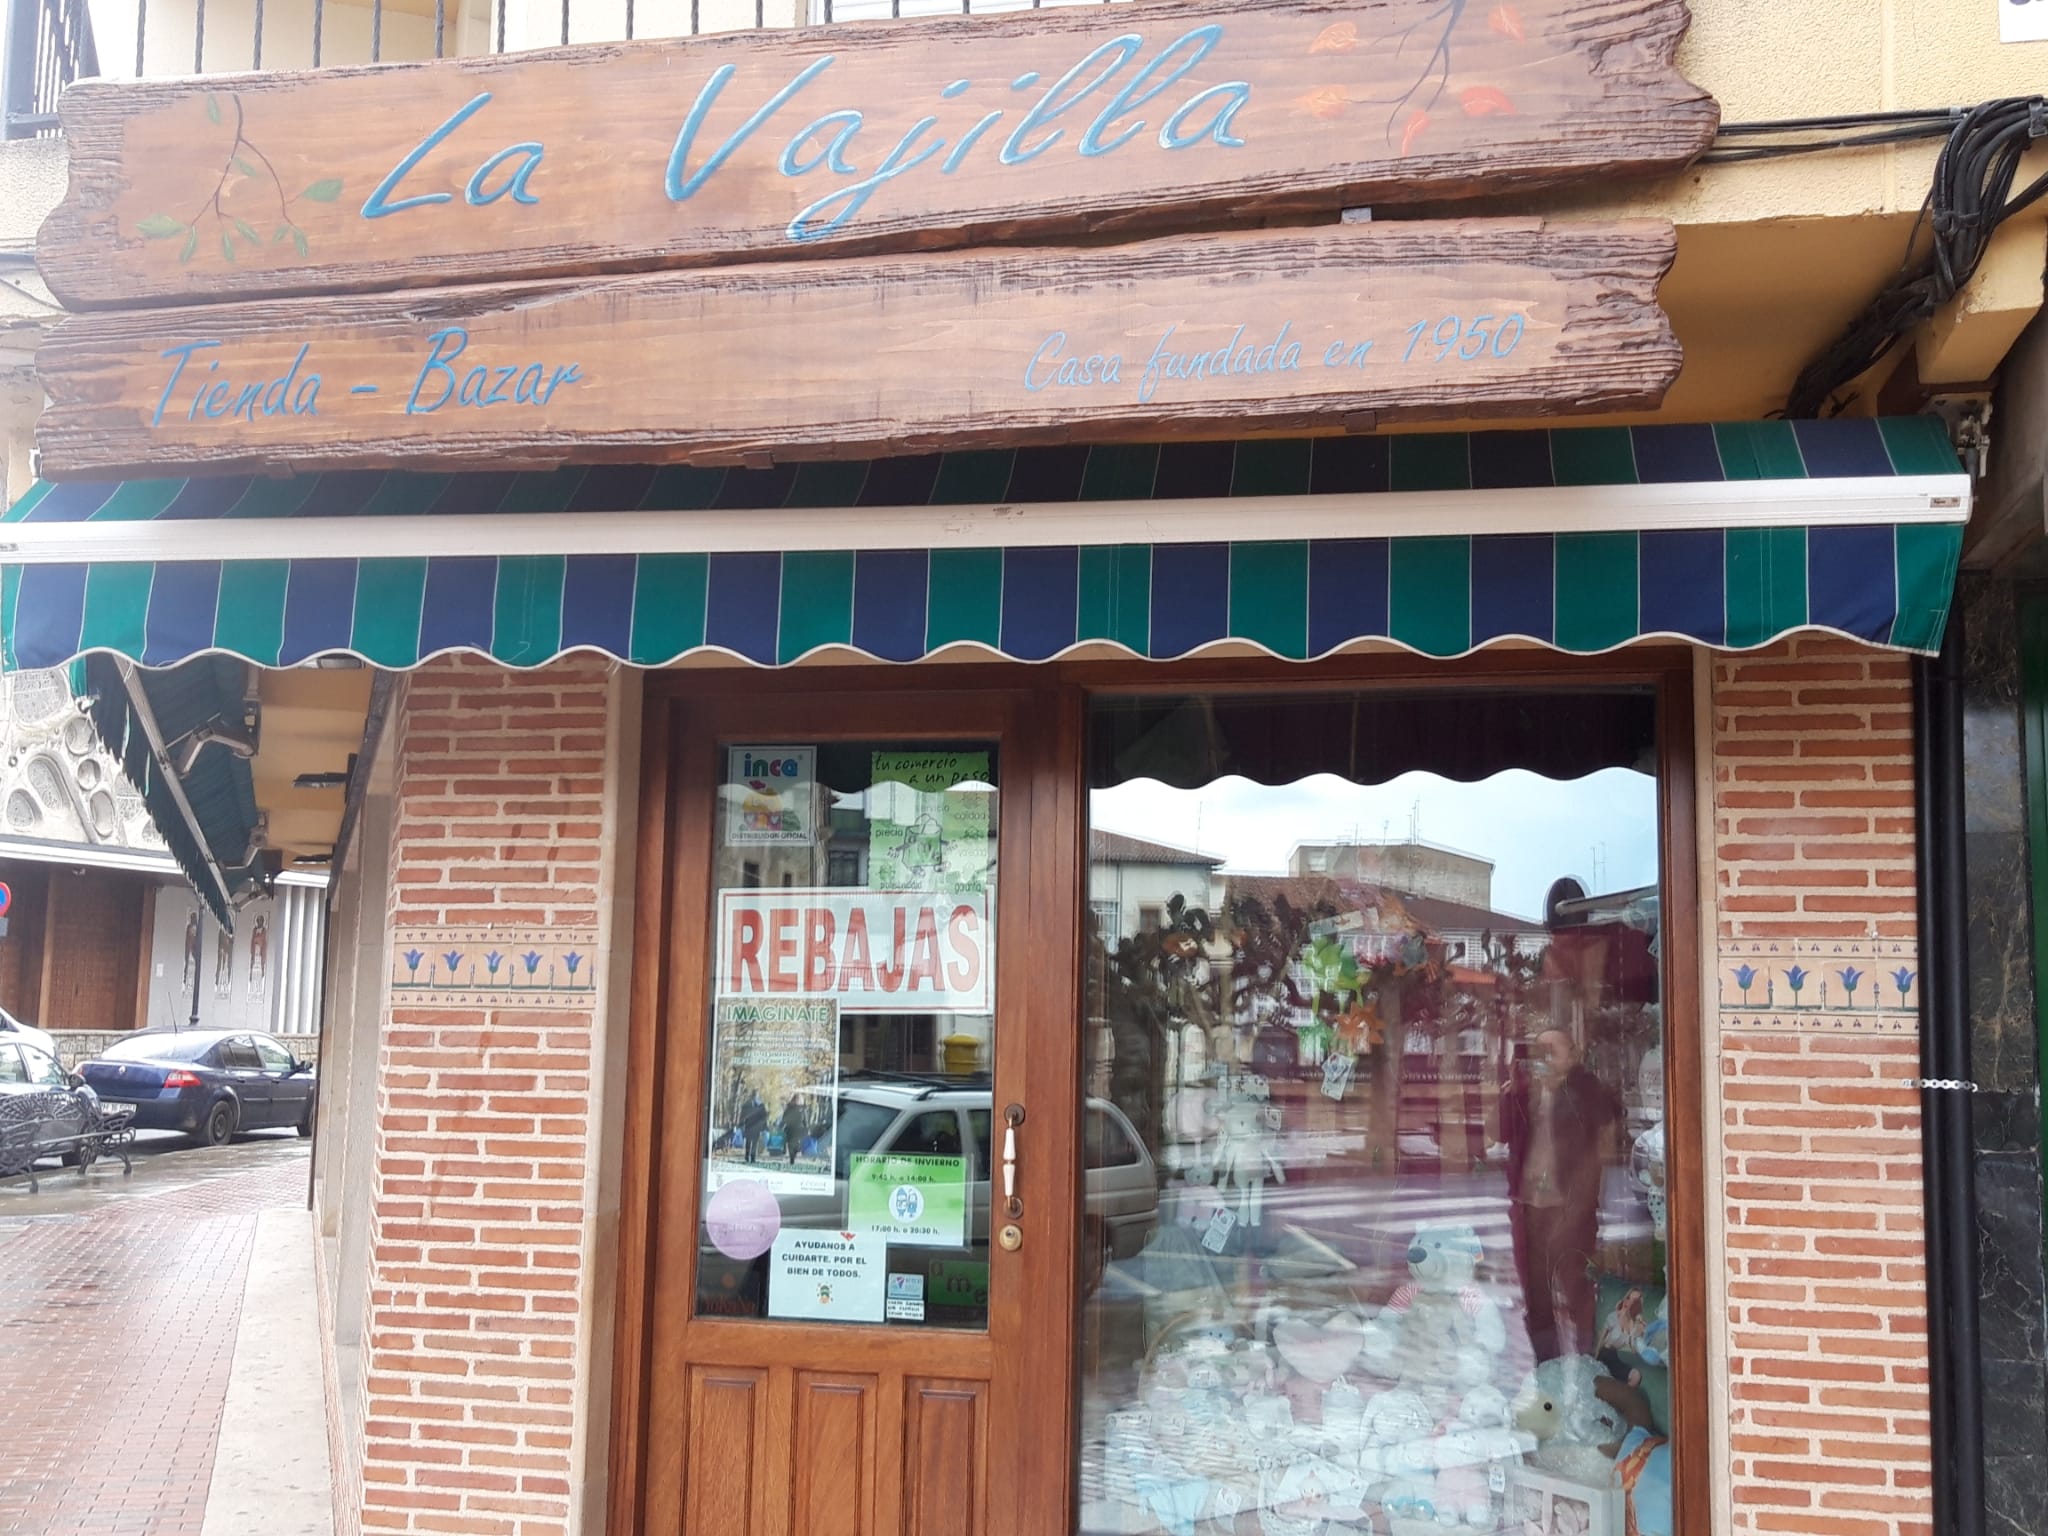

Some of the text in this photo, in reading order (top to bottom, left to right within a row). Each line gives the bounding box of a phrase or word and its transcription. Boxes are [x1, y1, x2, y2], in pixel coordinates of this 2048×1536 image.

[360, 22, 1251, 244] La Vajilla
[1024, 312, 1525, 404] Casa fundada en 1950
[152, 338, 321, 428] Tienda
[405, 325, 583, 416] Bazar
[743, 752, 798, 777] inca
[874, 755, 958, 771] tu comercio
[925, 774, 945, 784] un
[875, 827, 904, 838] precio
[729, 904, 981, 993] REBAJAS
[726, 1005, 830, 1023] IMAGINATE
[855, 1155, 898, 1165] HORARIO
[914, 1158, 960, 1167] INVIERNO
[794, 1240, 855, 1251] AYUDANOS A
[834, 1256, 853, 1265] POR
[856, 1257, 867, 1265] EL
[787, 1267, 809, 1276] BIEN
[812, 1268, 824, 1276] DE
